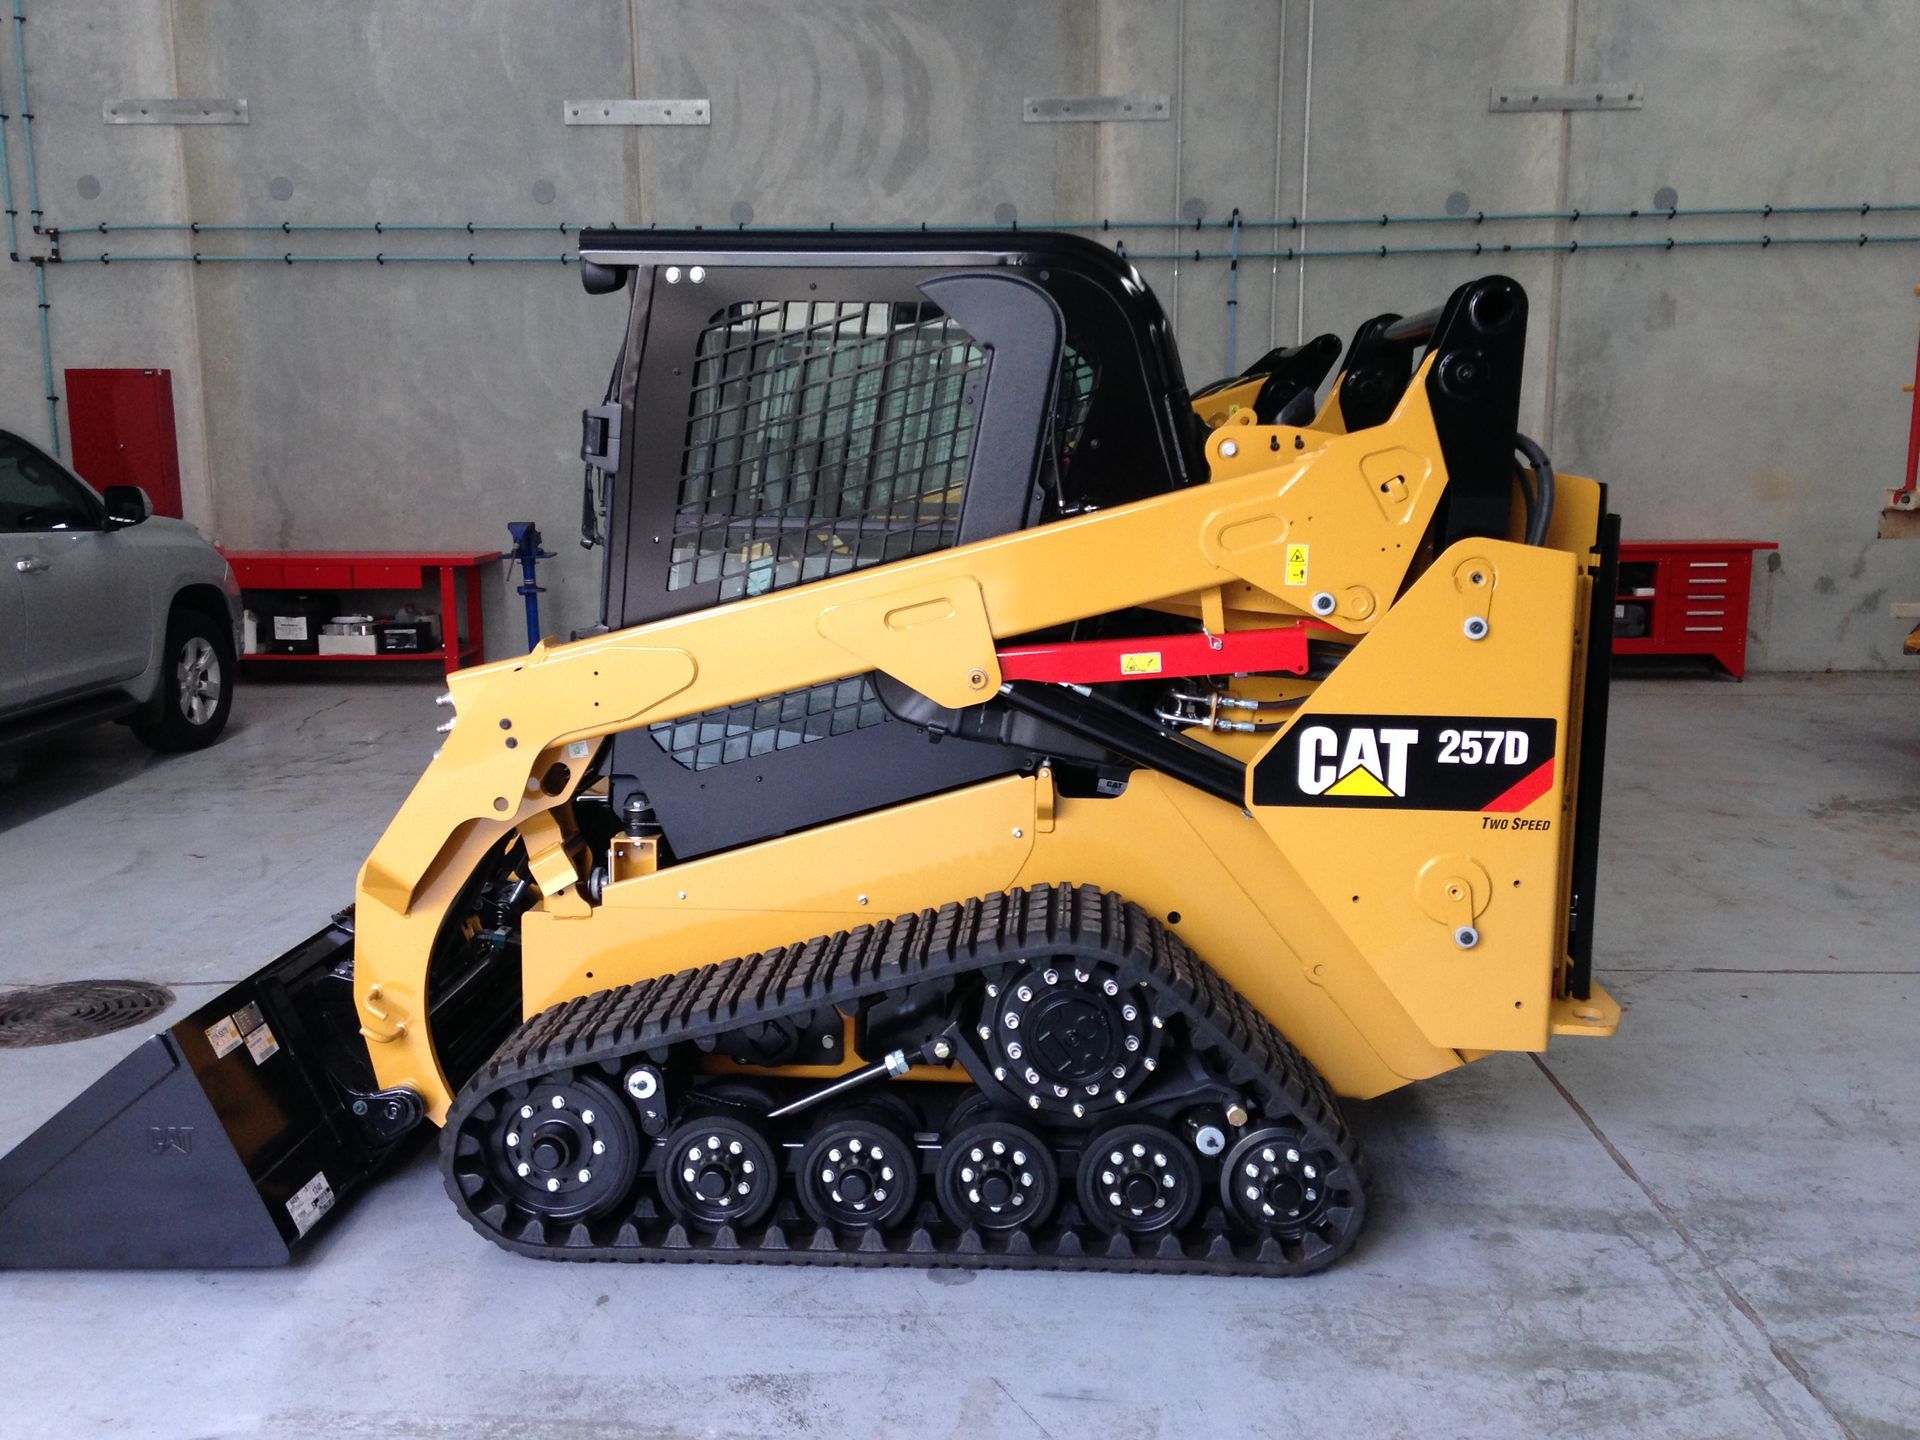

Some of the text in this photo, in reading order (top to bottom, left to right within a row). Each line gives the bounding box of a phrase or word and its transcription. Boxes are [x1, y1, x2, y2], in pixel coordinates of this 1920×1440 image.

[1298, 726, 1530, 798] CAT 257D
[1106, 780, 1123, 789] CAT
